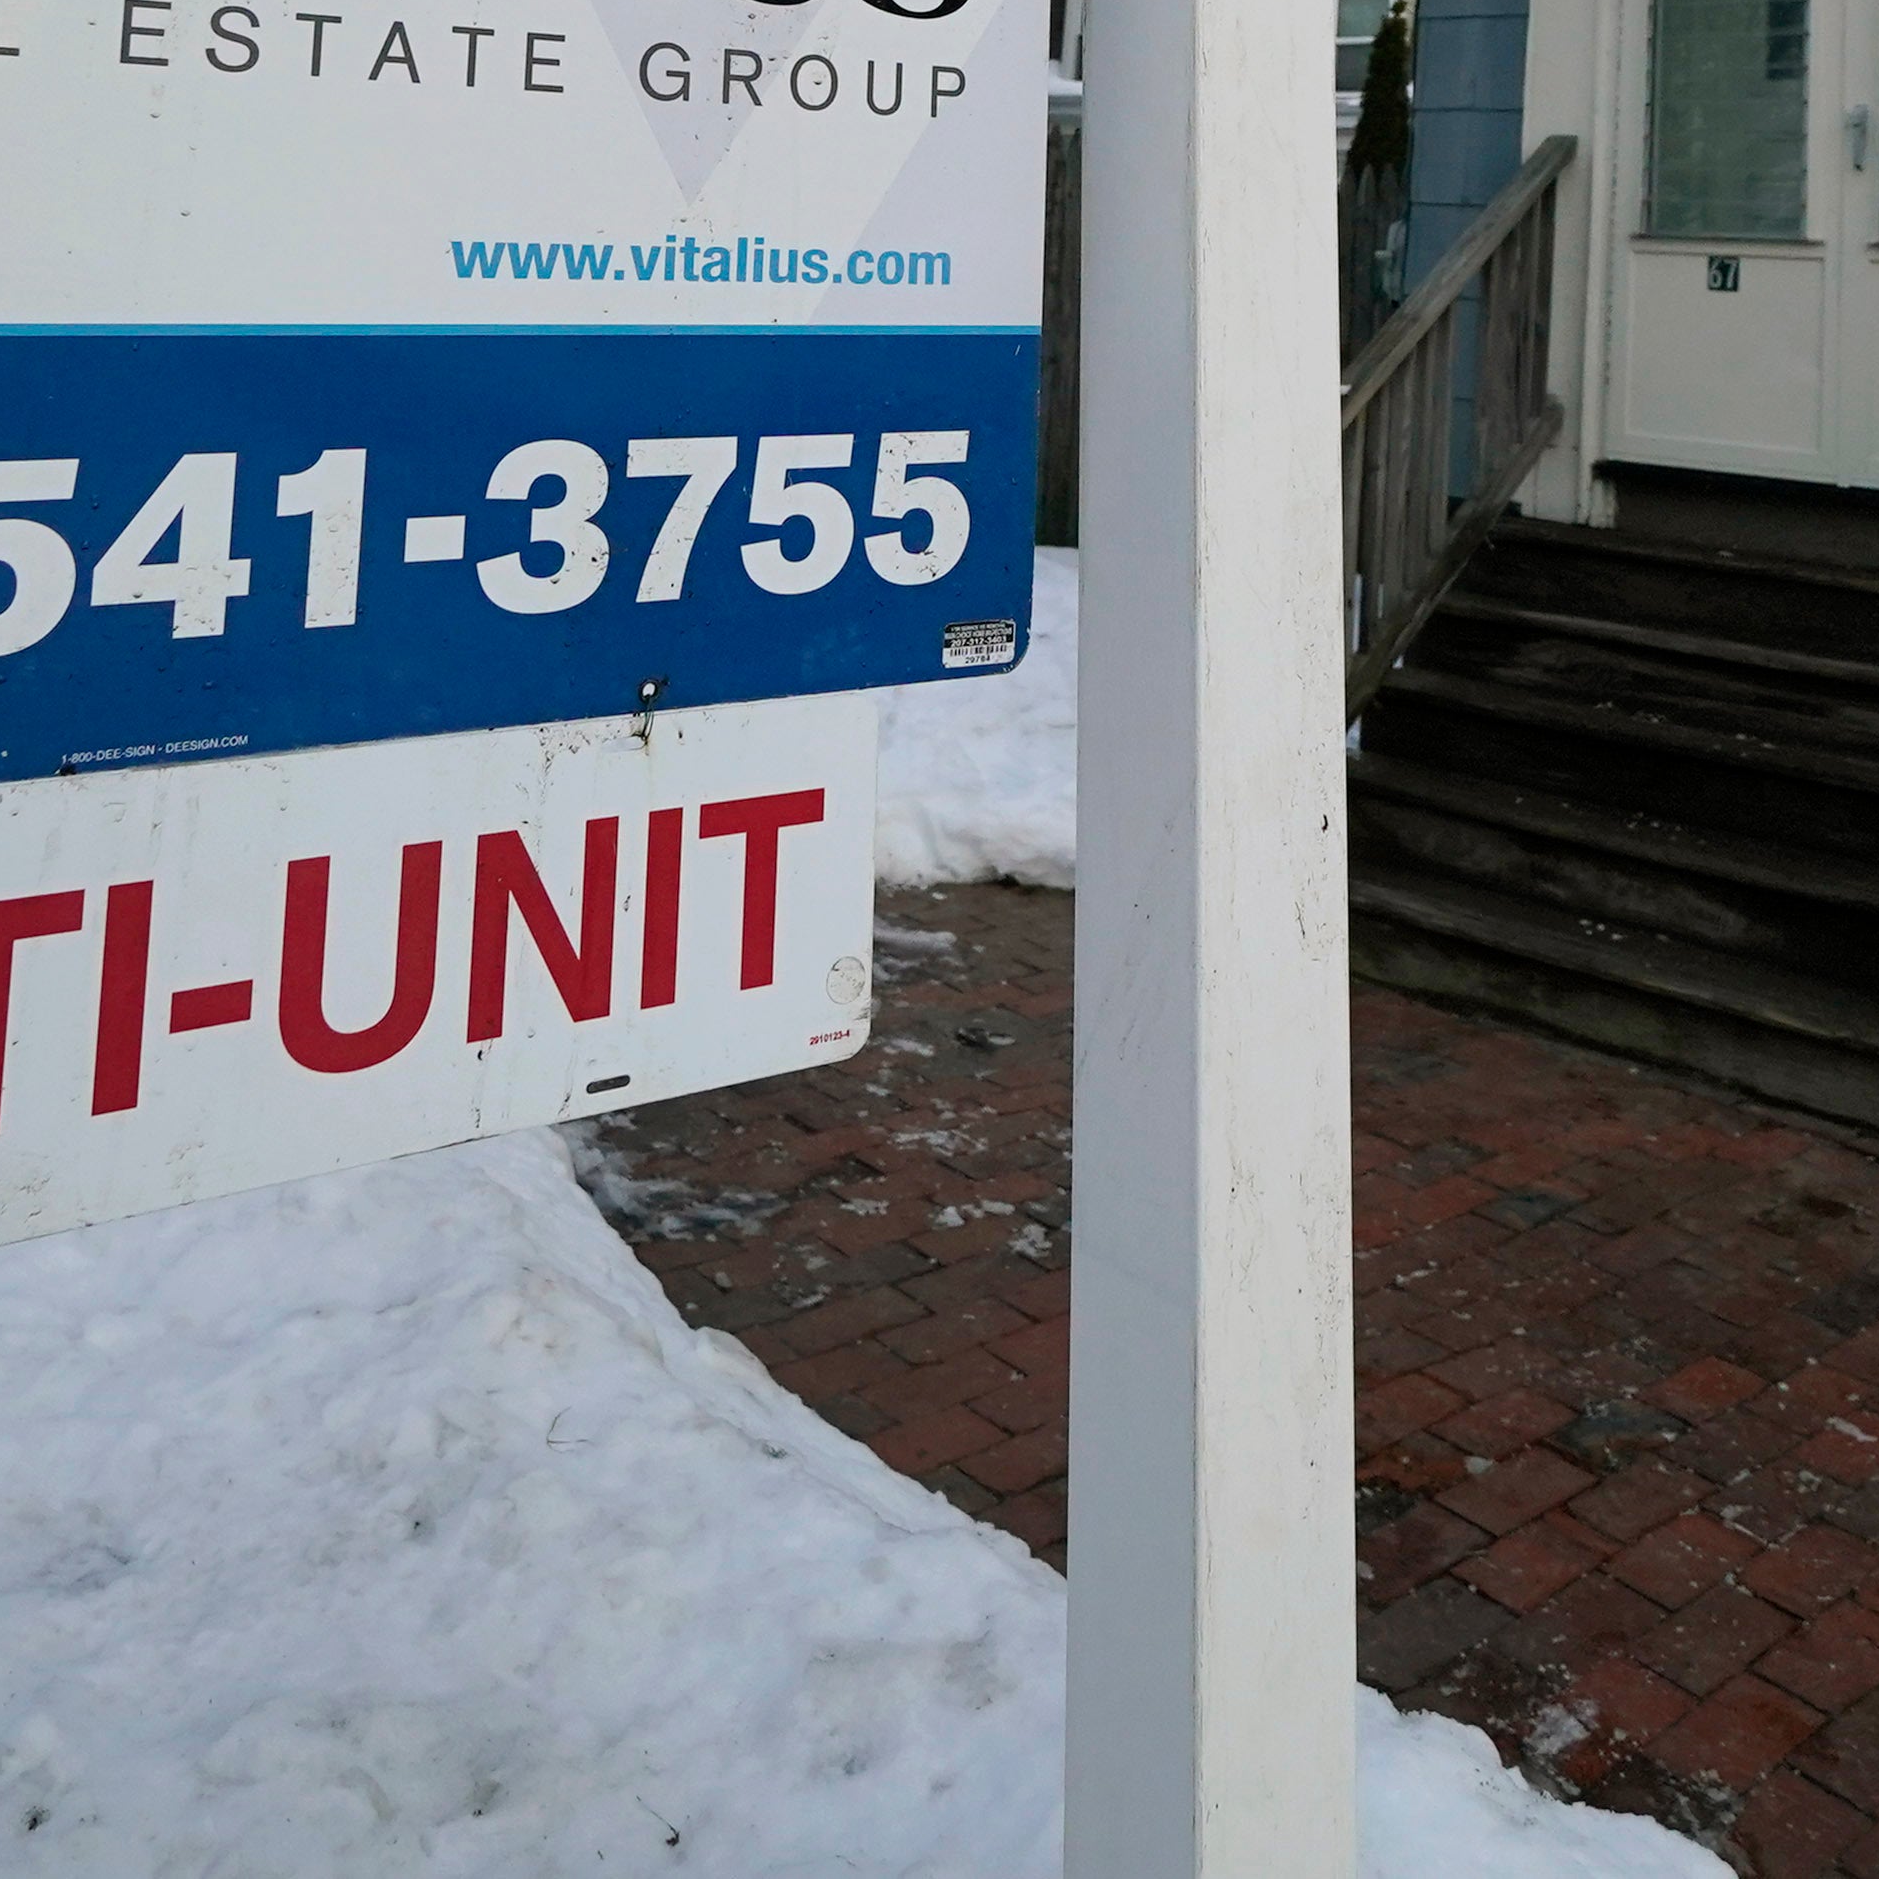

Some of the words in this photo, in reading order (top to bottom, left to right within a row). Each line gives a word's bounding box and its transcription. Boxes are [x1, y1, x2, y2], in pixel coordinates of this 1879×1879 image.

[638, 42, 967, 119] GROUP
[451, 234, 952, 286] www.vitalius.com
[1709, 258, 1739, 289] 67
[61, 743, 156, 766] 1-800-DEE-SIGN
[165, 734, 249, 754] DEESIGN.COM
